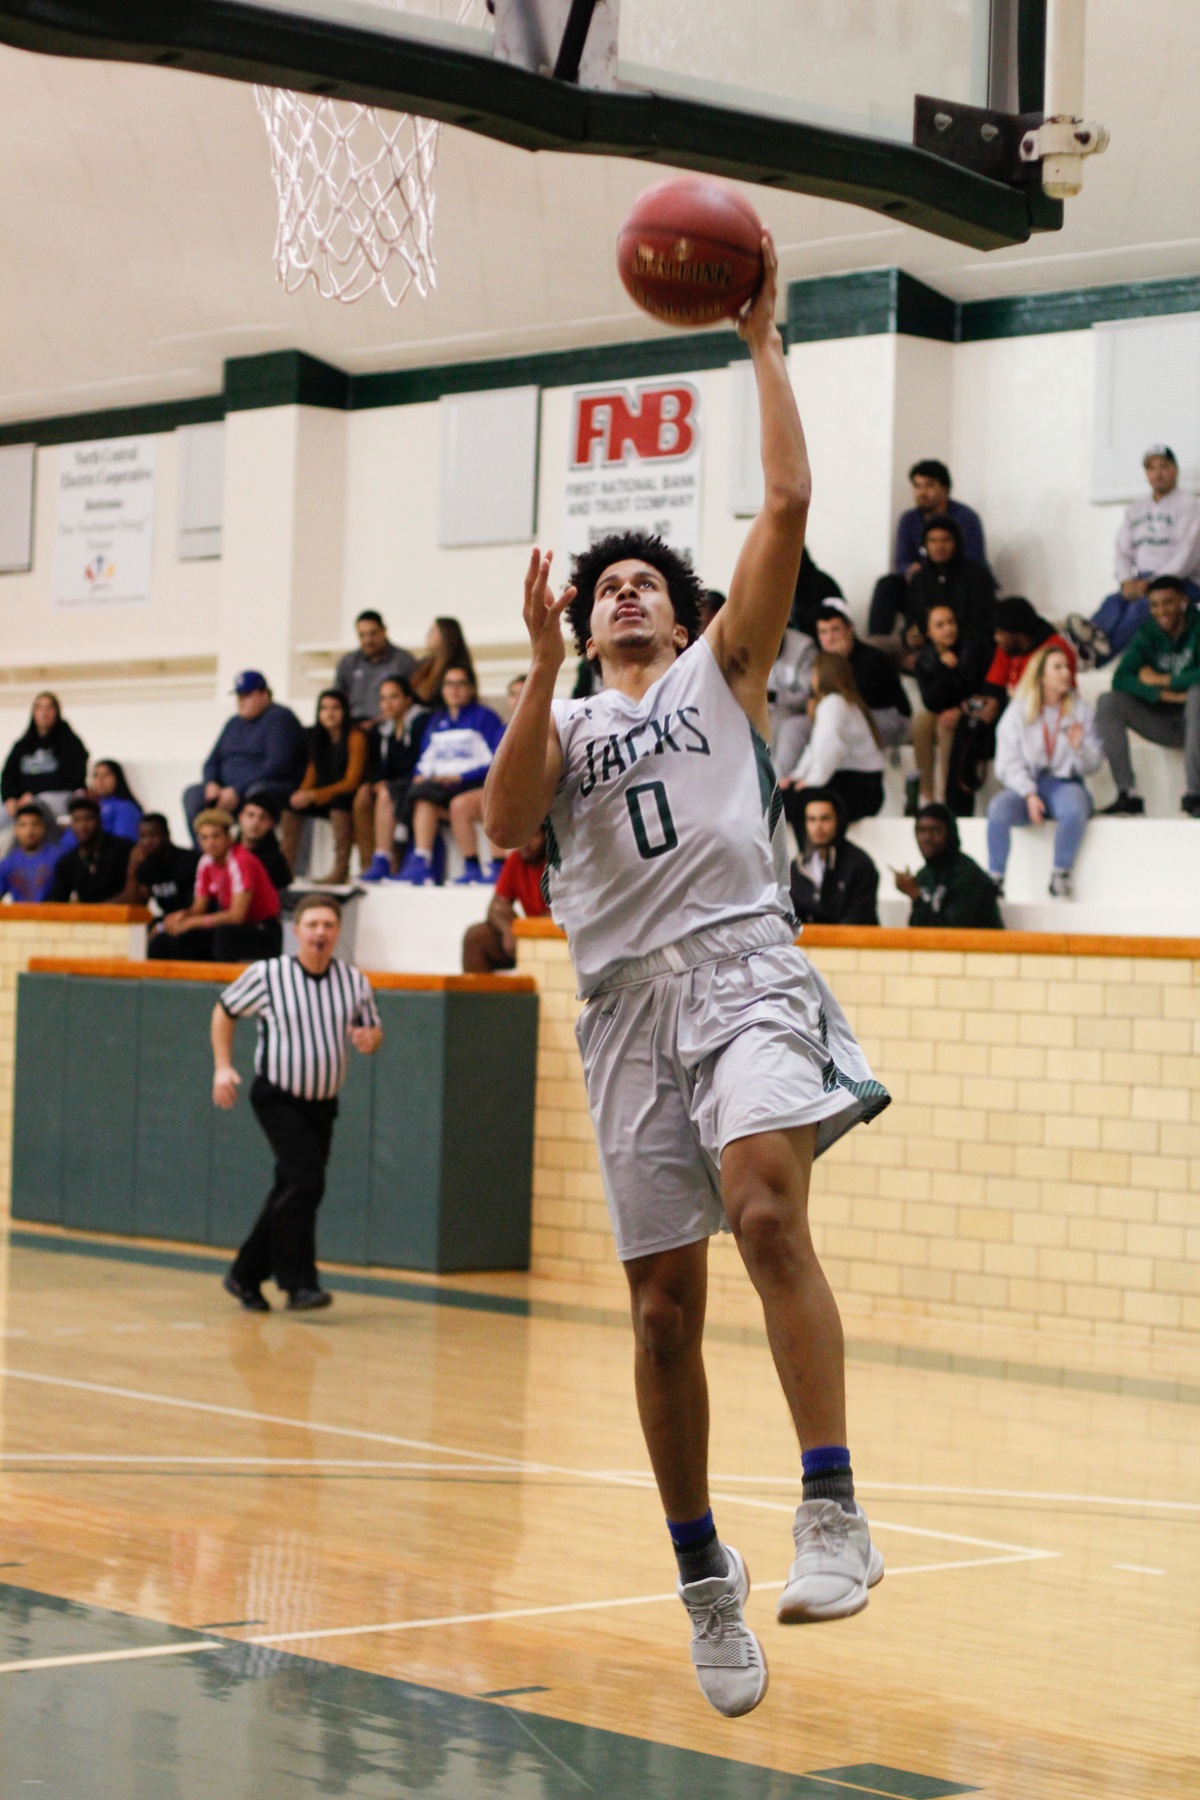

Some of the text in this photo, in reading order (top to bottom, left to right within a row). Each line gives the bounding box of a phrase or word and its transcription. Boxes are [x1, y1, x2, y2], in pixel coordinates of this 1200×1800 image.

[571, 382, 698, 470] FNB
[580, 706, 711, 798] JACKS
[624, 780, 679, 860] 0
